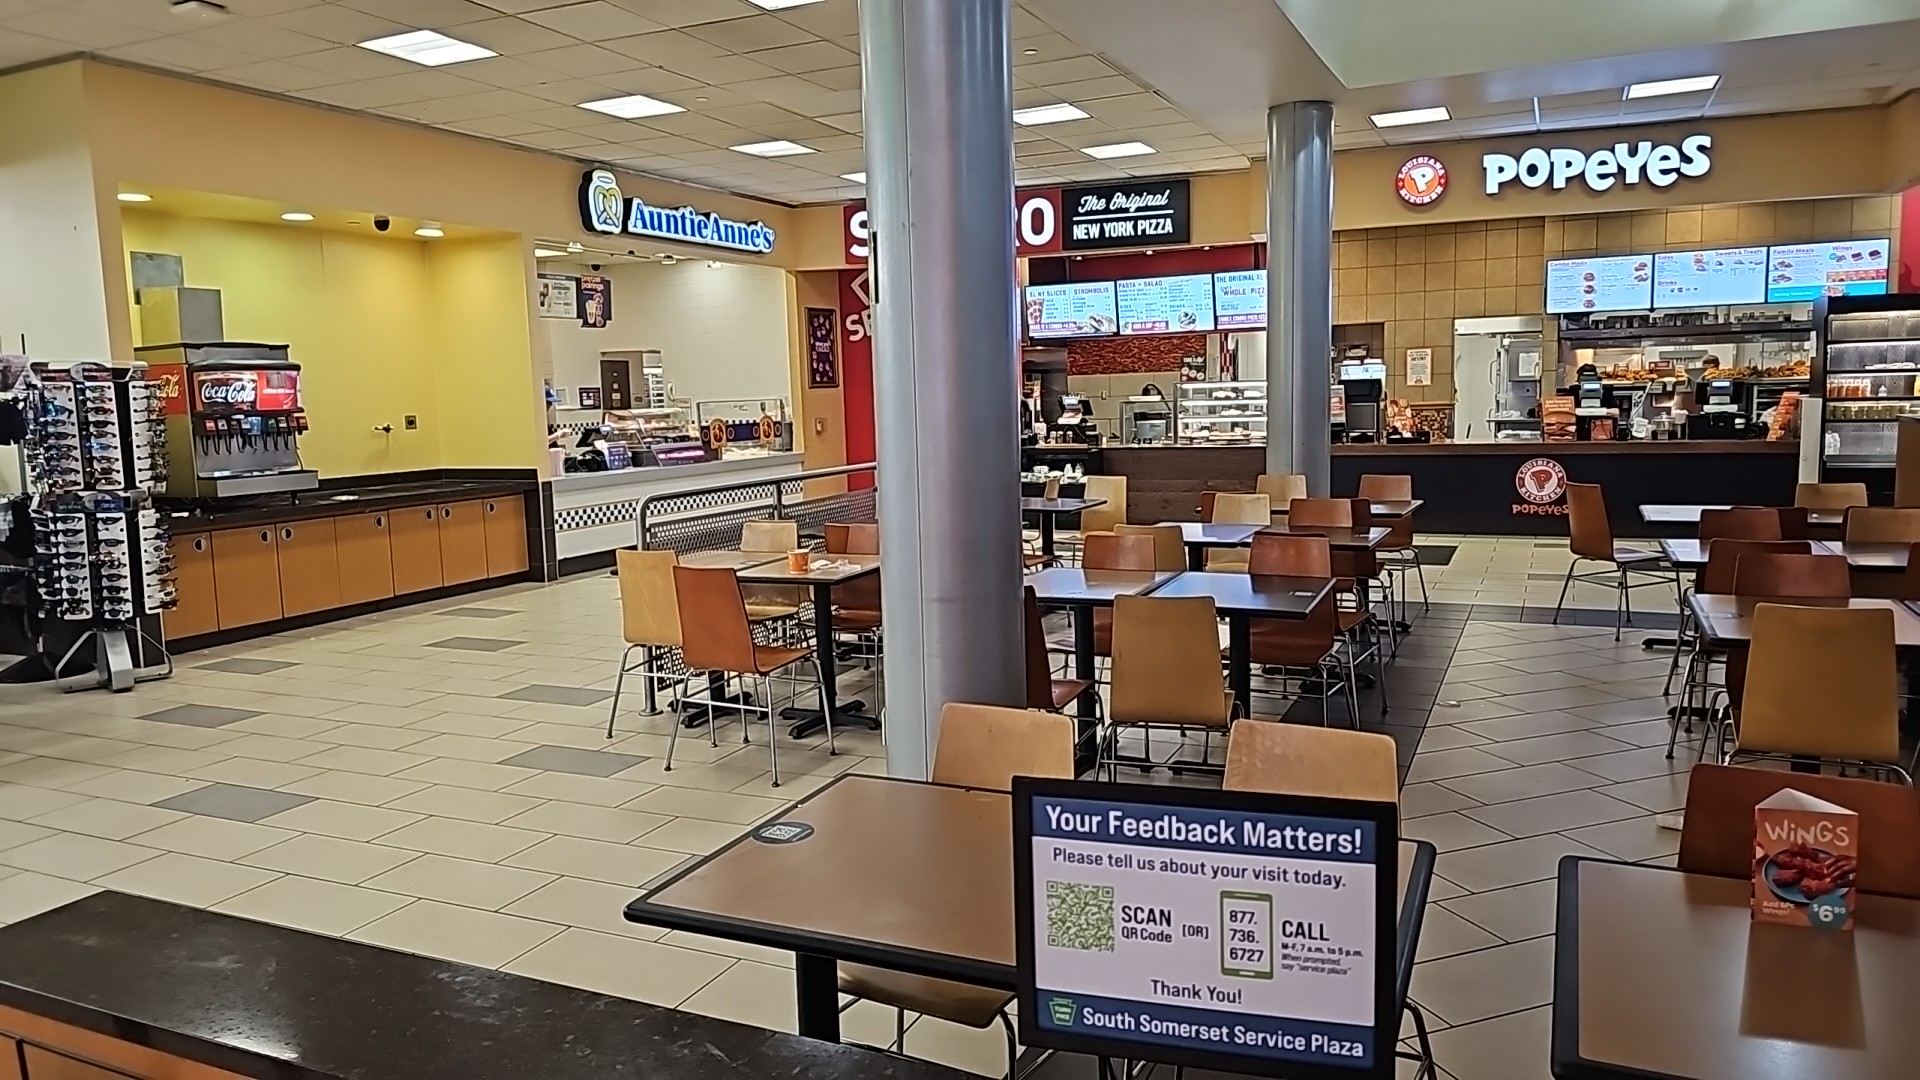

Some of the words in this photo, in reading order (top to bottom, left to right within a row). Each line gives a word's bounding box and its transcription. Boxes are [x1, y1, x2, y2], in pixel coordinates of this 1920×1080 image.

[1398, 157, 1445, 179] LOUISIANA
[1078, 195, 1106, 213] The
[1109, 189, 1170, 212] Original
[1399, 186, 1443, 204] KITCHEN
[632, 202, 708, 239] Auntie
[710, 216, 773, 250] Anne's
[1073, 223, 1100, 240] NEW
[1103, 220, 1135, 238] YORK
[1137, 218, 1173, 236] PIZZA
[1229, 274, 1255, 282] ORIGINAL
[1073, 287, 1109, 295] STROMBOLIS
[1223, 288, 1247, 296] WHOLE
[1519, 460, 1563, 478] LOUISIANA
[1520, 486, 1561, 501] KITCHEN
[1045, 805, 1102, 833] Your
[1108, 810, 1236, 845] Feedback
[1243, 820, 1362, 854] Matters!
[1053, 847, 1103, 866] Please
[1107, 853, 1132, 869] tell
[1137, 858, 1155, 871] us
[1159, 858, 1207, 876] about
[1211, 864, 1248, 879] your
[1252, 865, 1289, 883] visit
[1294, 869, 1346, 889] today.
[1121, 905, 1172, 927] SCAN
[1229, 909, 1258, 925] 877.
[1121, 926, 1139, 940] QR
[1140, 928, 1172, 943] Code
[1182, 924, 1209, 940] [OR]
[1228, 928, 1260, 944] 736.
[1281, 920, 1330, 941] CALL
[1229, 947, 1264, 963] 6727
[1281, 953, 1302, 962] When
[1300, 943, 1305, 952] 7
[1327, 947, 1336, 955] to
[1338, 947, 1343, 956] 5
[1281, 963, 1295, 971] say
[1151, 979, 1202, 1000] Thank
[1206, 985, 1242, 1004] You!
[1082, 1007, 1136, 1031] South
[1139, 1013, 1230, 1042] Somerset
[1233, 1025, 1306, 1051] Service
[1310, 1034, 1364, 1056] Plaza
